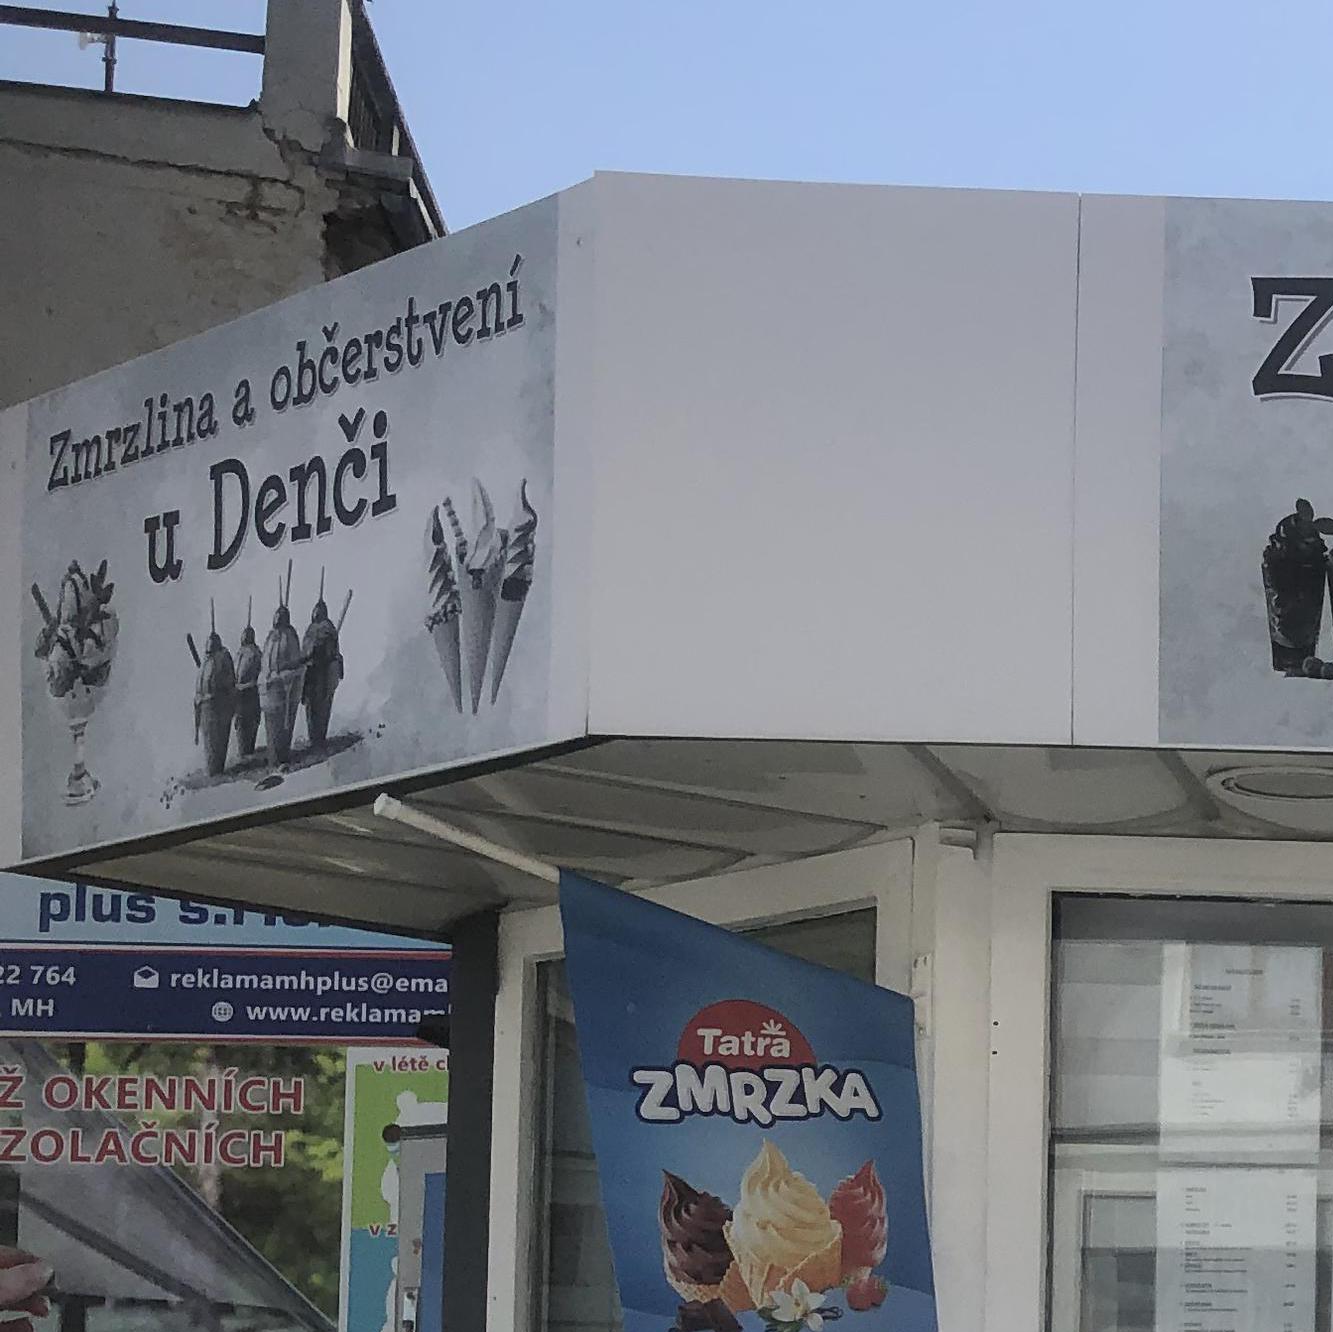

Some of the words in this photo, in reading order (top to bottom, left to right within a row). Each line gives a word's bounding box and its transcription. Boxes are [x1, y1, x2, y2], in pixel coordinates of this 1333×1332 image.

[47, 390, 221, 494] Zmrzlina
[232, 378, 256, 427] a
[270, 254, 526, 414] občerstvení
[143, 508, 183, 583] u
[206, 406, 399, 572] Denči
[39, 885, 156, 932] plus
[30, 965, 76, 986] 764
[170, 967, 449, 995] reklamamhplus@ema
[11, 998, 55, 1018] MH
[247, 1002, 451, 1023] www.reklama
[696, 1018, 791, 1060] Tatra
[373, 1060, 385, 1072] v
[391, 1055, 429, 1072] létě
[0, 1066, 25, 1110] Ž
[42, 1067, 304, 1114] OKENNÍCH
[632, 1064, 881, 1126] ZMRZKA
[0, 1120, 285, 1167] ZOLAČNÍCH
[369, 1224, 381, 1236] v
